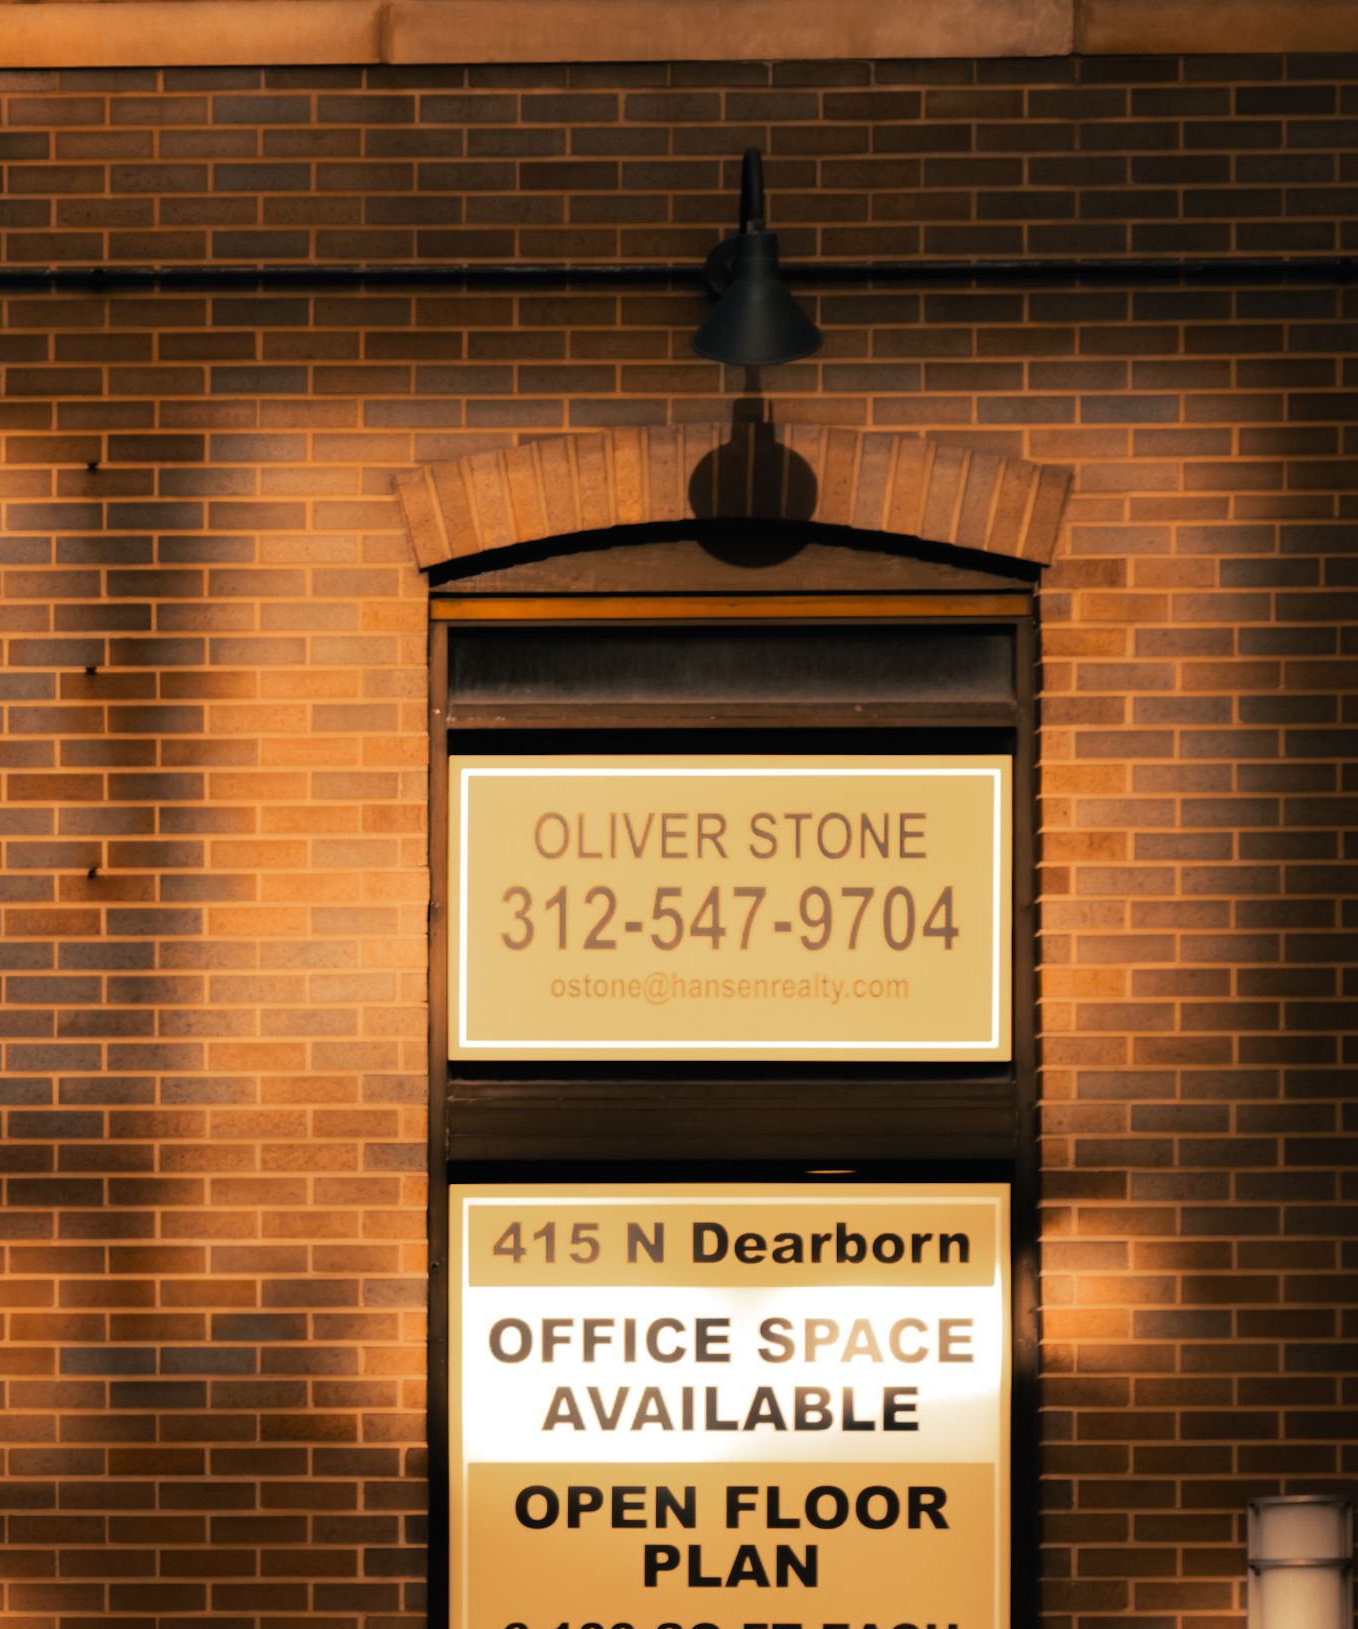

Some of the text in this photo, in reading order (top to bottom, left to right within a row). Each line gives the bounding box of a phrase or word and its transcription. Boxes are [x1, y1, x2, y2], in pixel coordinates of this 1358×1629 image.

[533, 811, 928, 860] OLIVER STONE
[499, 884, 959, 951] 312-547-9704
[549, 971, 910, 1005] ostone@hansenrealty.com
[492, 1221, 971, 1264] 415 N Dearborn
[488, 1316, 975, 1364] OFFICE SPACE
[541, 1385, 920, 1432] AVAILABLE
[514, 1484, 951, 1531] OPEN FLOOR
[642, 1544, 819, 1588] PLAN
